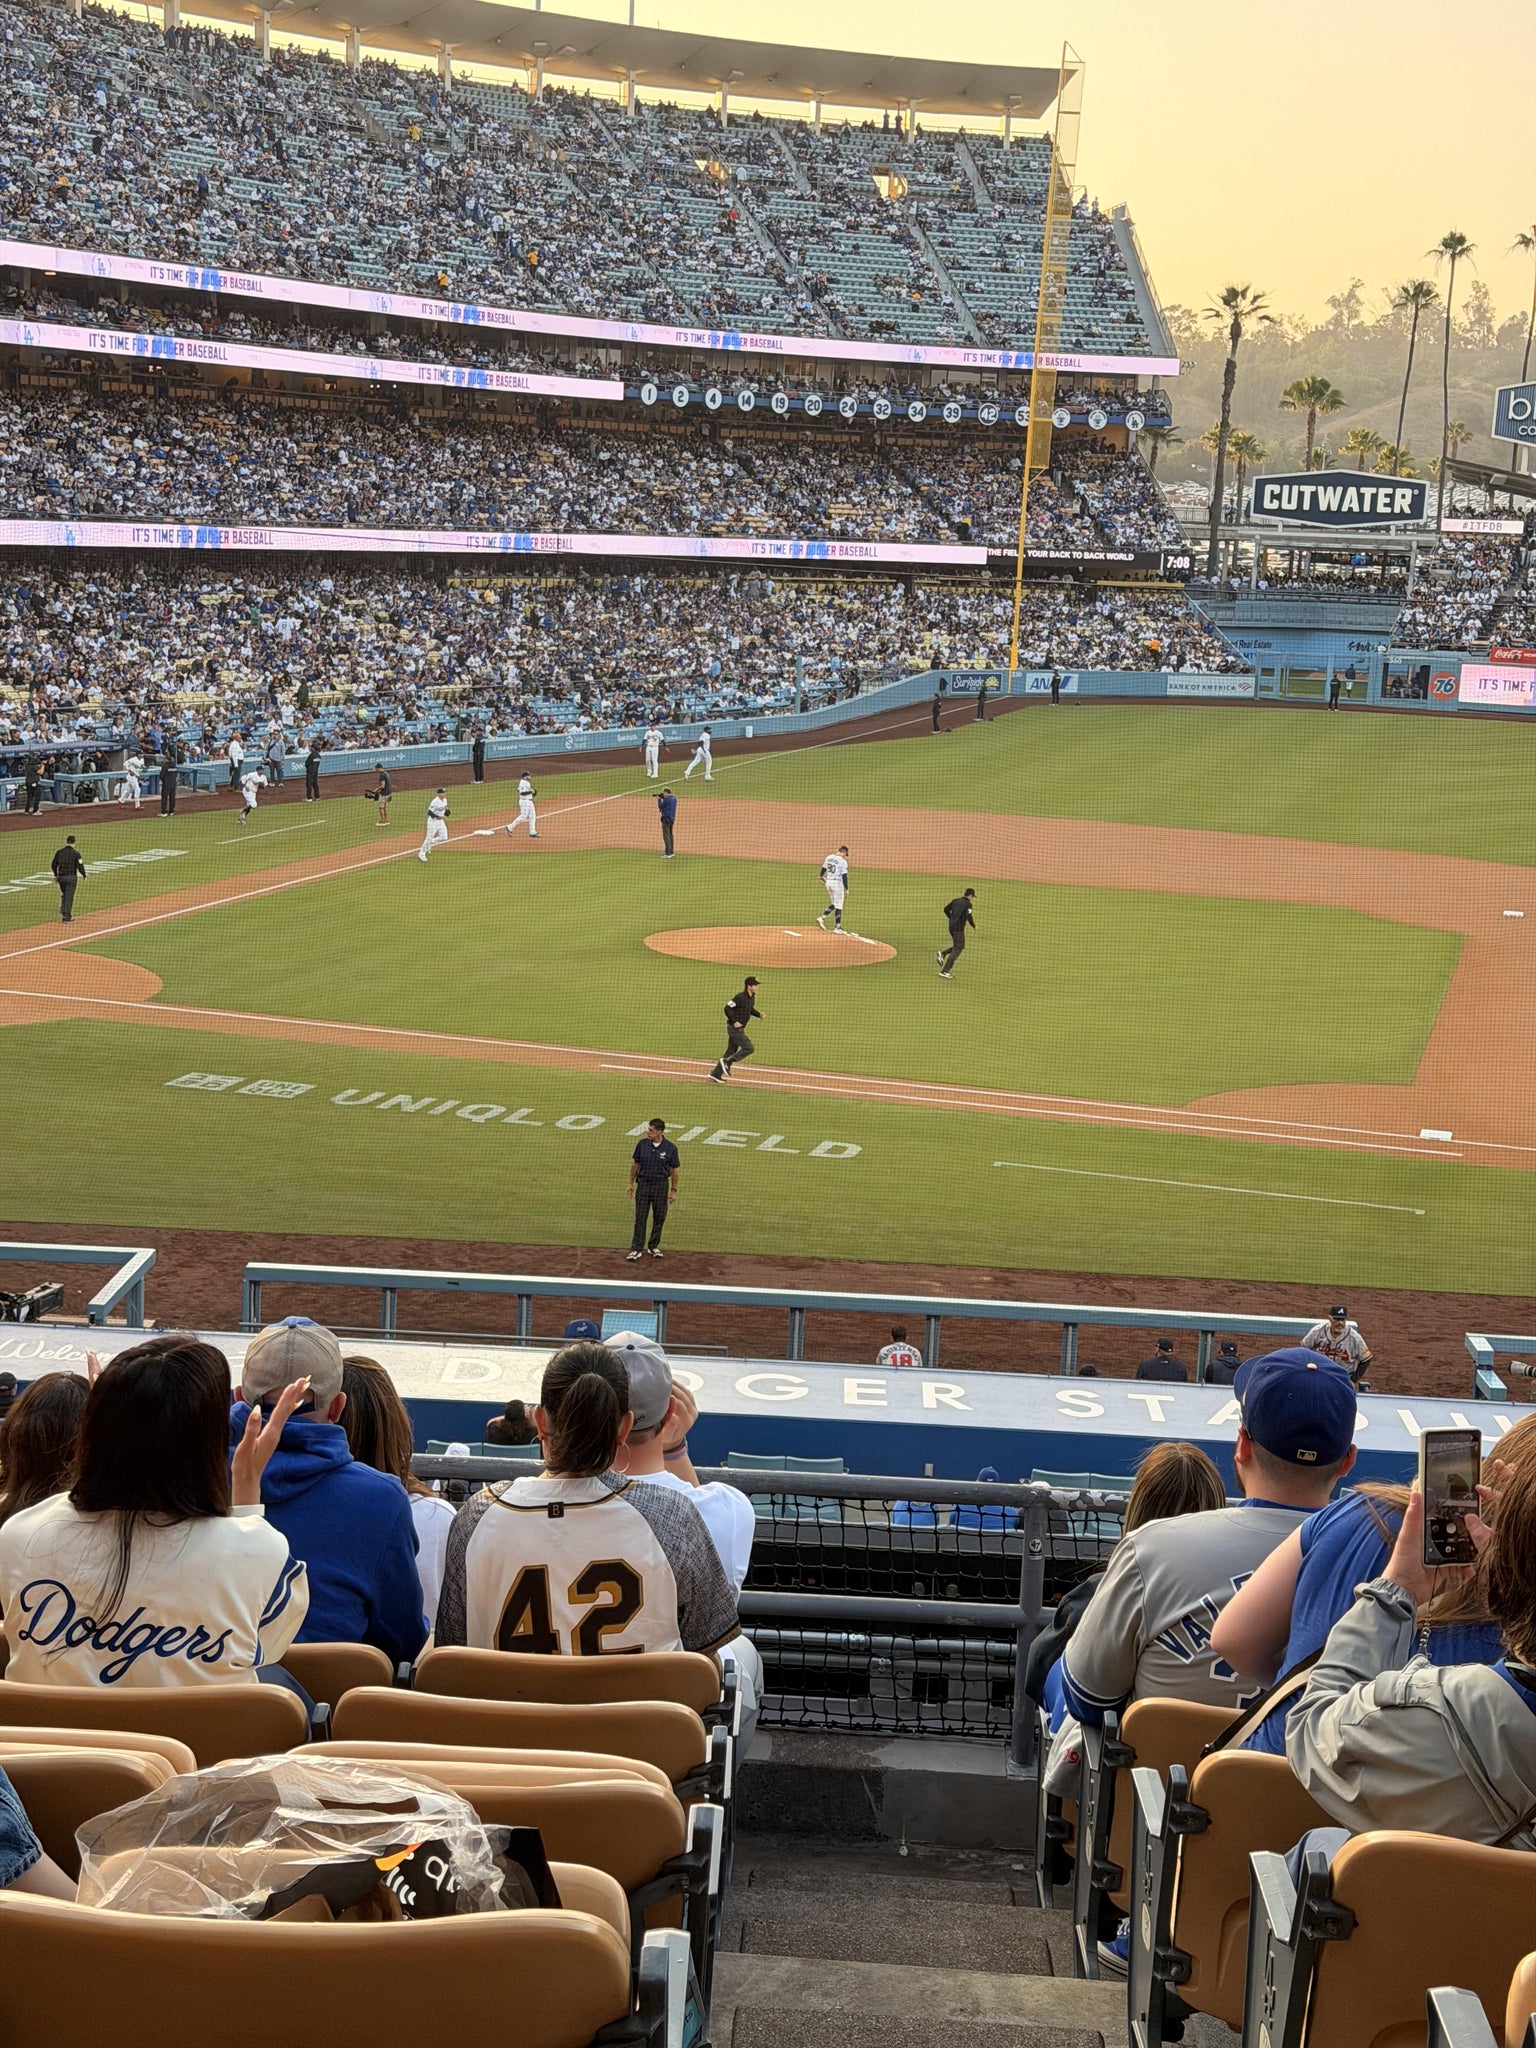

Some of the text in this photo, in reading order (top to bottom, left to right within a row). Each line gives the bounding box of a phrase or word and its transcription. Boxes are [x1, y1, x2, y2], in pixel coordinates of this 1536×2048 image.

[150, 266, 164, 280] IT'S
[166, 269, 184, 283] TIME
[230, 277, 264, 293] BASEBALL
[421, 302, 434, 315] IT'S
[435, 304, 449, 317] TIME
[487, 310, 516, 326] BASEBALL
[89, 333, 107, 348] IT'S
[108, 335, 130, 350] TIME
[187, 343, 228, 361] BASEBALL
[675, 331, 689, 343] IT'S
[690, 332, 706, 344] TIME
[749, 337, 783, 350] BASEBALL
[963, 352, 978, 363] IT'S
[980, 353, 997, 364] TIME
[1014, 355, 1043, 368] DODGR
[1045, 357, 1082, 368] BASEBALL
[418, 367, 431, 380] IT'S
[433, 368, 451, 382] TIME
[496, 374, 530, 390] BASEBALL
[740, 395, 751, 407] 14
[774, 397, 786, 409] 19
[807, 399, 821, 411] 20
[841, 401, 856, 413] 24
[875, 403, 889, 415] 32
[910, 405, 925, 418] 34
[945, 407, 959, 419] 39
[980, 407, 997, 421] 42
[1263, 484, 1413, 514] CUTWATER
[1462, 521, 1503, 532] #ITFDB
[132, 527, 150, 543] IT'S
[153, 529, 174, 544] TIME
[232, 531, 274, 546] BASEBALL
[751, 542, 767, 554] IT'S
[769, 543, 787, 555] TIME
[838, 545, 878, 558] BASEBALL
[988, 548, 1135, 561] THE FIEL, YOUR BACK TO BACK WORLD
[1166, 555, 1191, 569] 7:08
[1434, 678, 1456, 693] 76
[1478, 678, 1499, 691] IT'S
[1502, 679, 1527, 692] TIME
[330, 1088, 863, 1159] UNIQLO FIELD
[438, 1357, 973, 1410] DGER
[493, 1558, 645, 1657] 42
[19, 1578, 234, 1685] Dodgers
